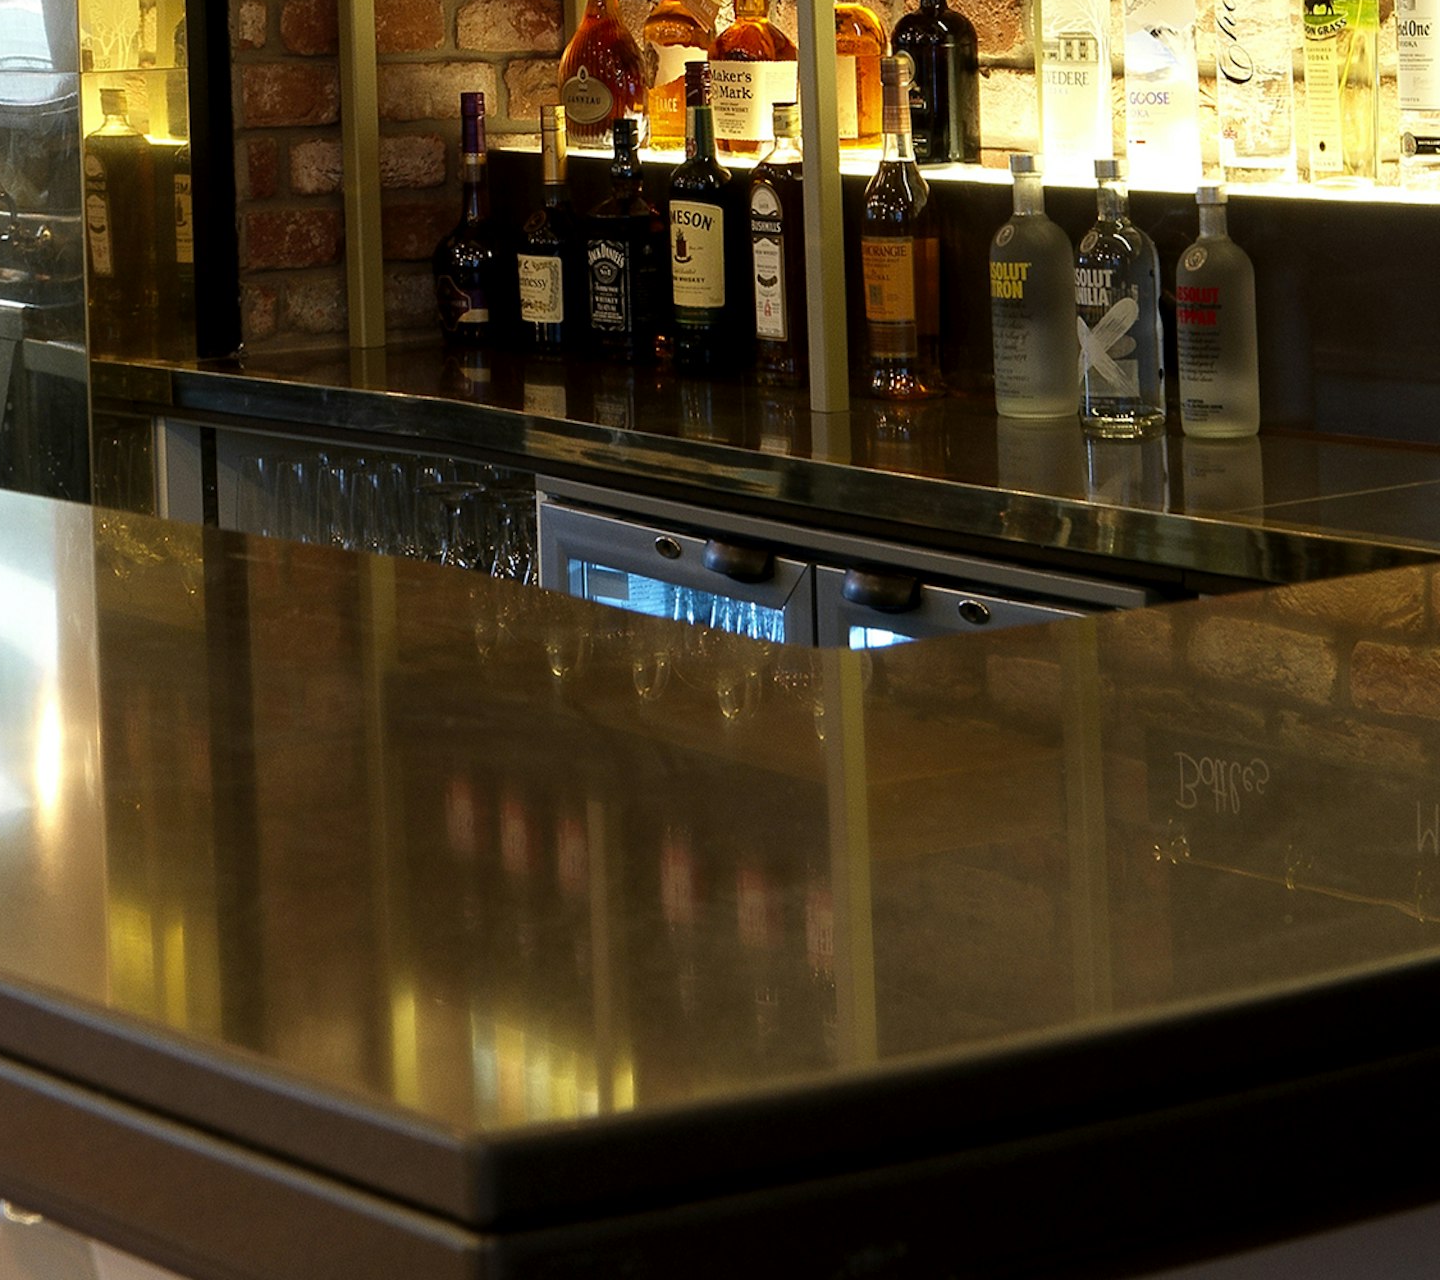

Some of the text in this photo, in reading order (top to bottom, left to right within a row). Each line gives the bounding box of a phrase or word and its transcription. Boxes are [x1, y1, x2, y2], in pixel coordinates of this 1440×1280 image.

[1317, 18, 1347, 36] GRASS
[1409, 22, 1430, 37] One
[720, 86, 753, 100] Mark
[1129, 91, 1170, 105] GOOSE
[670, 209, 713, 231] MESON
[751, 220, 781, 233] BUSHMILLS
[990, 262, 1029, 281] SOLUT
[1075, 269, 1113, 288] SOLUT
[991, 280, 1023, 299] TRON
